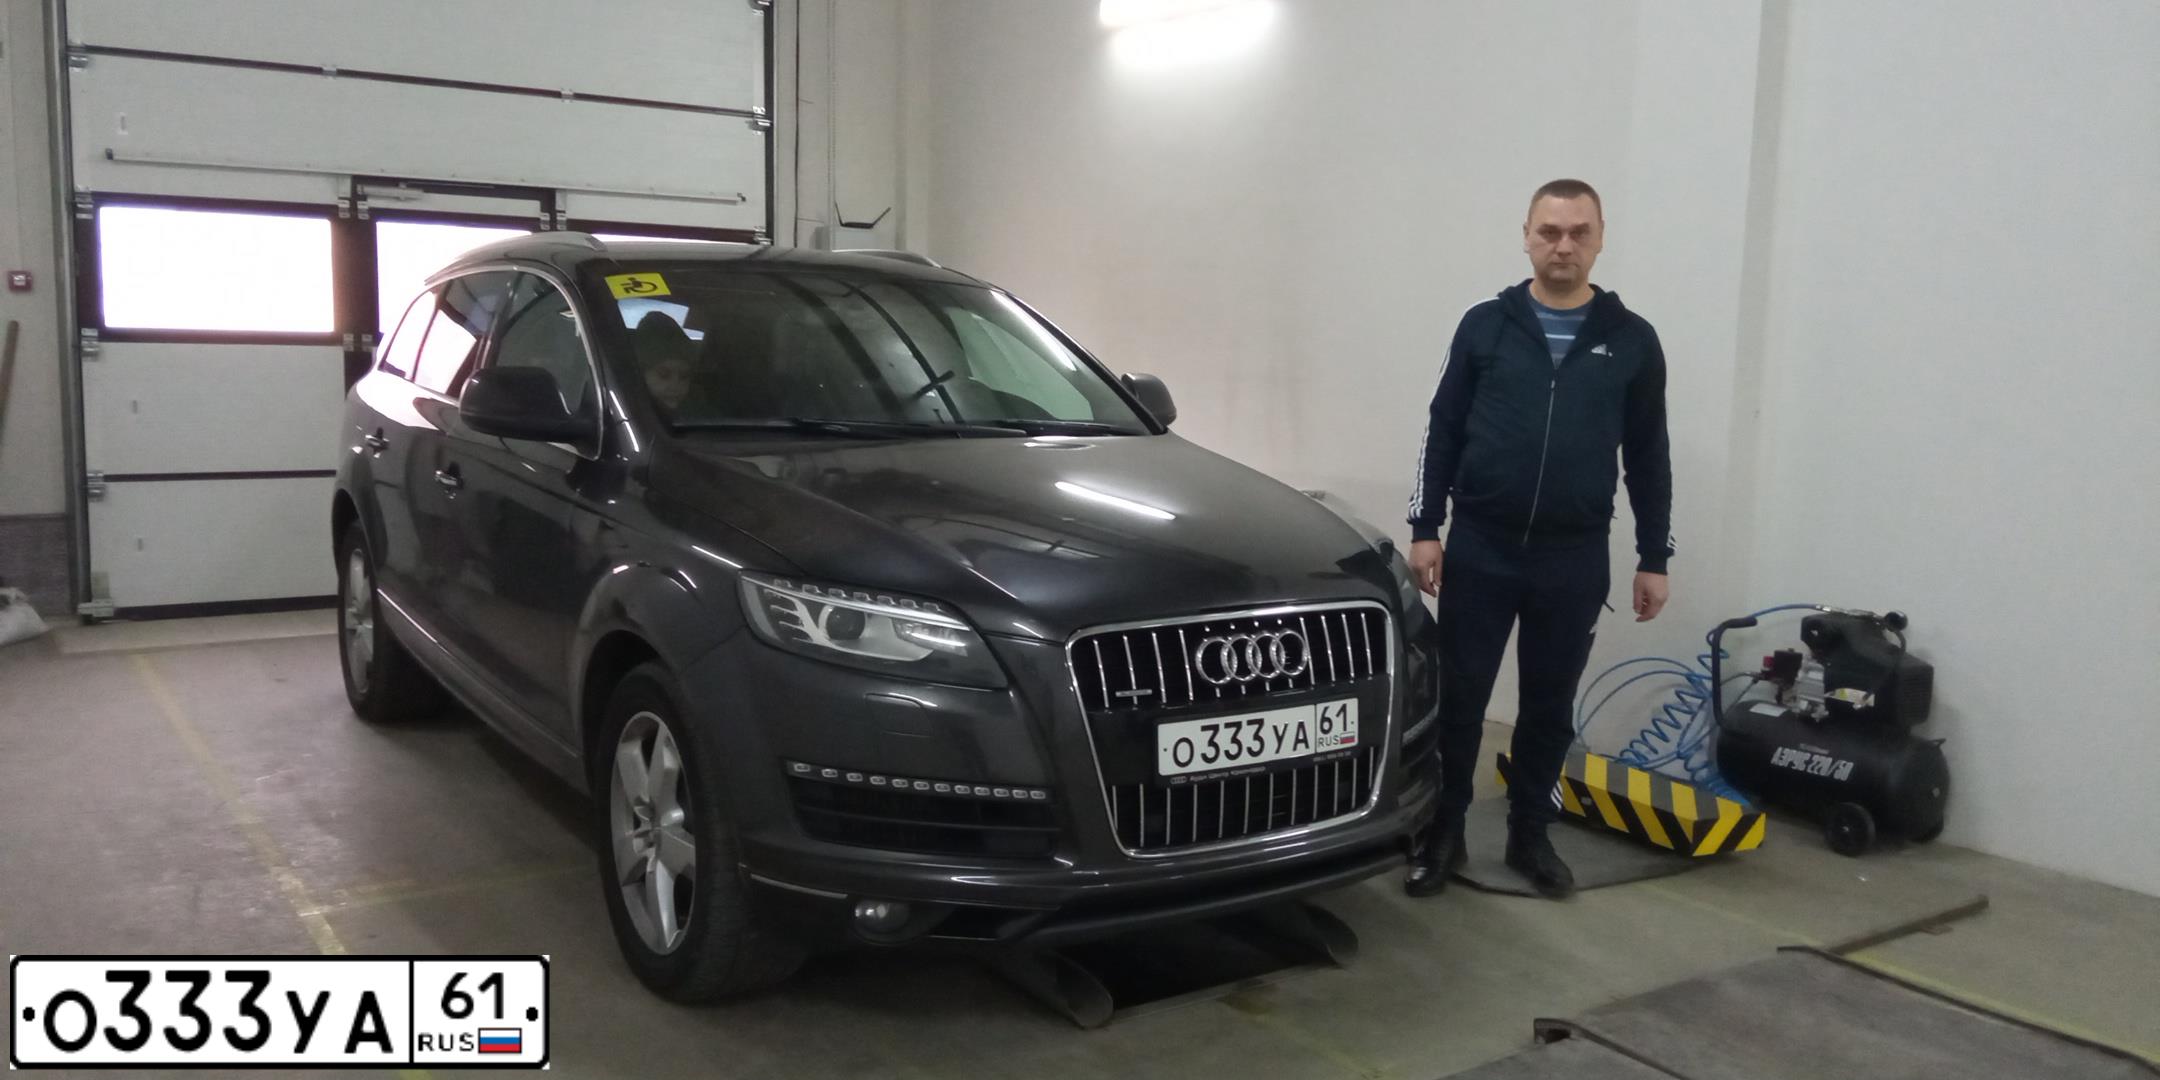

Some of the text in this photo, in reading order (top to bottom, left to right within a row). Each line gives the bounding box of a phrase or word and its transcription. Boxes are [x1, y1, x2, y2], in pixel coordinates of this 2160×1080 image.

[1172, 703, 1348, 768] О333УА 61
[1317, 735, 1339, 748] RUS
